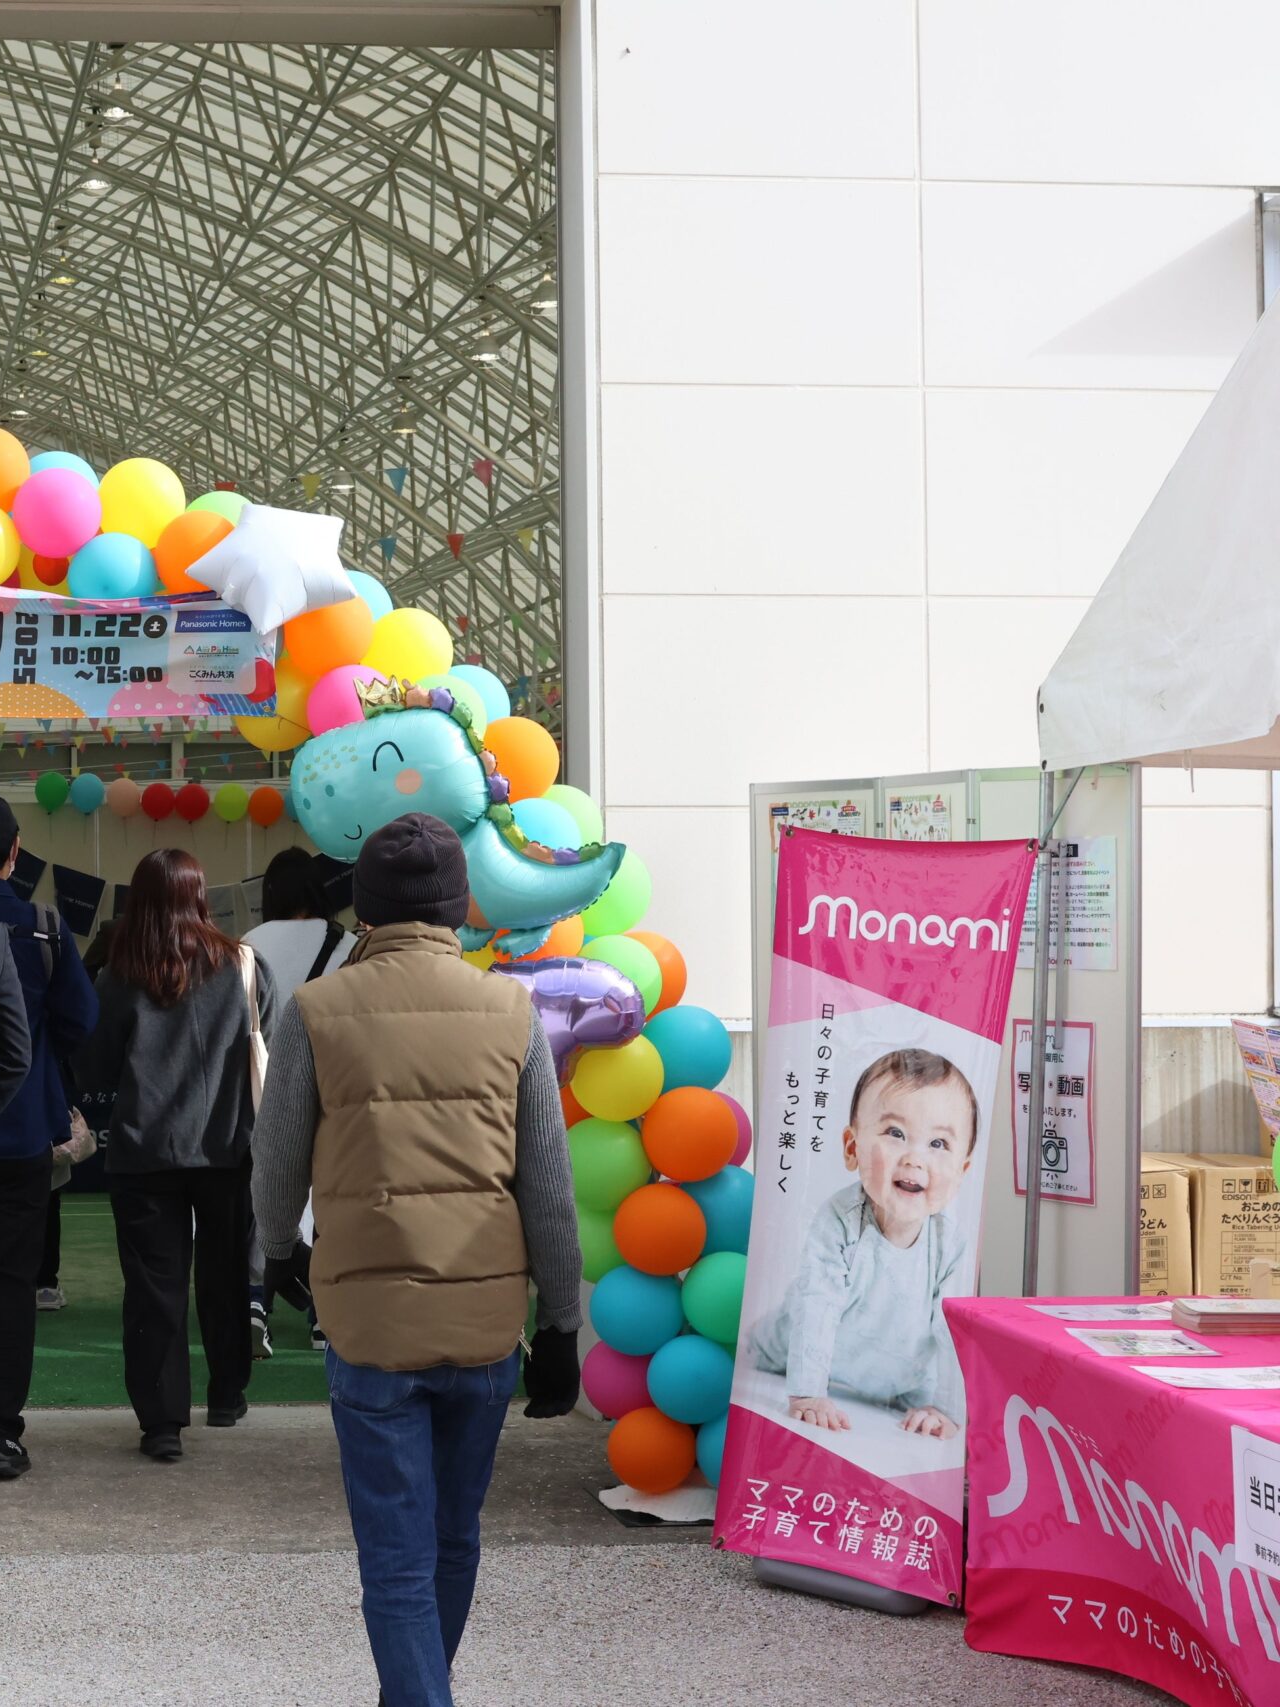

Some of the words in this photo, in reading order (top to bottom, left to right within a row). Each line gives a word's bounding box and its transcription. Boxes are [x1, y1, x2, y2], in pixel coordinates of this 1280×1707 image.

[52, 614, 141, 638] 11.22
[180, 620, 217, 629] Panasonic
[219, 620, 246, 628] Homes
[13, 612, 38, 684] 2025
[51, 647, 120, 665] 10:00
[189, 670, 235, 679] こくみん共済
[810, 1003, 835, 1153] 日々の子育てを
[1018, 1073, 1085, 1097] 写・動画
[777, 1071, 800, 1193] もっと楽しく
[1241, 1201, 1280, 1212] おこめの
[1140, 1219, 1167, 1230] うどん
[1250, 1476, 1280, 1516] 当日
[747, 1478, 938, 1540] ママのための
[742, 1503, 934, 1571] 子育て情報誌
